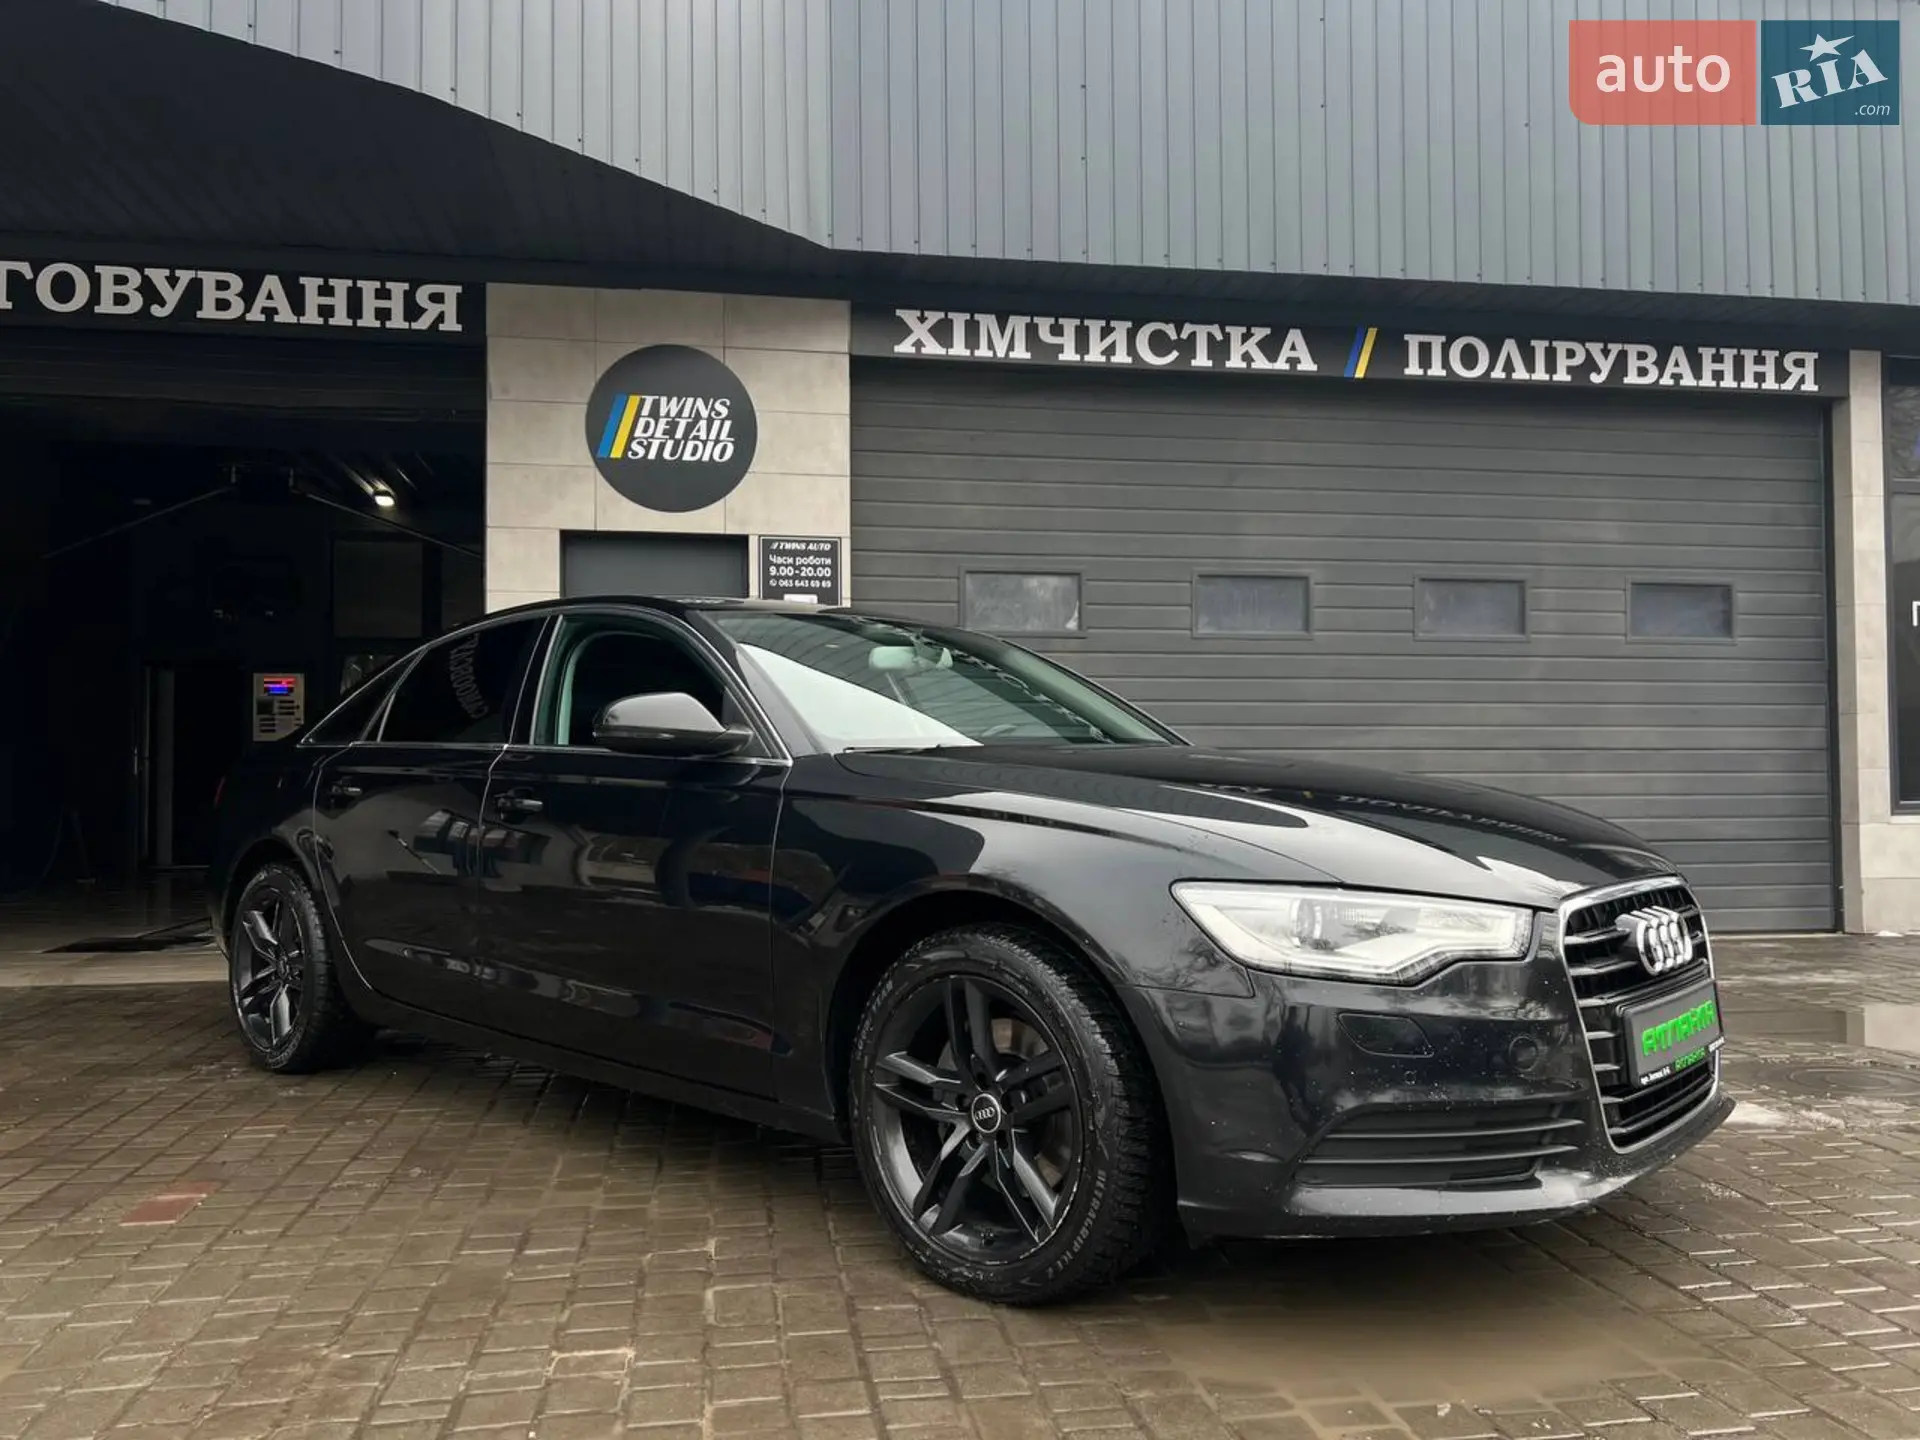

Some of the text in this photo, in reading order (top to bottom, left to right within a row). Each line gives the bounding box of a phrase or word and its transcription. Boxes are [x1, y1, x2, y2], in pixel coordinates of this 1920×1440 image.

[893, 308, 1318, 372] ХІМЧИСТКА
[1403, 333, 1819, 392] ПОЛІРУВАННЯ
[640, 395, 731, 419] TWINS
[633, 417, 735, 442] DETAIL
[627, 438, 735, 462] STUDIO
[807, 543, 831, 551] AUTO
[769, 554, 831, 566] Часи роботи
